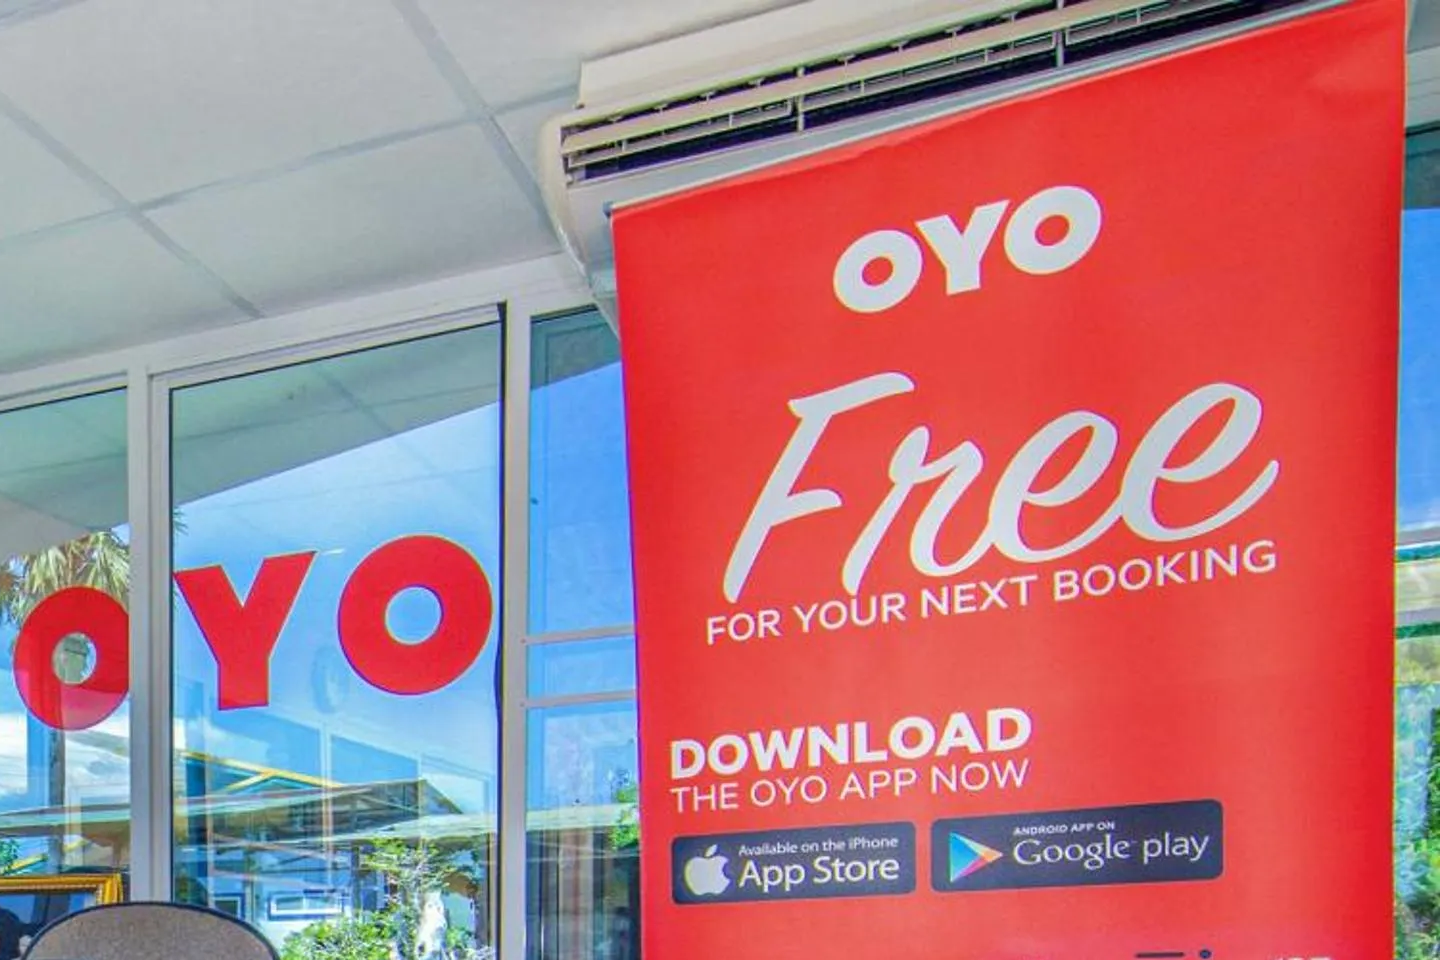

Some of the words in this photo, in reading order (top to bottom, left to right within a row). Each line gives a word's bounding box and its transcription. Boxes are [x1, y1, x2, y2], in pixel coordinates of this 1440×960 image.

[833, 185, 1101, 313] OYO
[723, 372, 1279, 603] Free
[706, 609, 781, 645] FOR
[792, 592, 906, 633] YOUR
[921, 575, 1037, 618] NEXT
[1053, 541, 1277, 601] BOOKING
[13, 534, 493, 731] OYO
[671, 708, 1032, 779] DOWNLOAD
[670, 782, 739, 813] THE
[750, 776, 827, 807] OYO
[840, 768, 916, 800] APP
[931, 758, 1030, 793] NOW
[738, 843, 798, 857] Available
[801, 842, 820, 852] on
[822, 838, 846, 852] the
[848, 836, 899, 850] iPhone
[1013, 825, 1068, 836] ANDROID
[1070, 823, 1094, 832] APP
[1096, 821, 1115, 831] ON
[1013, 834, 1131, 871] Google
[1143, 831, 1210, 865] play
[738, 860, 806, 893] App
[812, 855, 900, 884] Store
